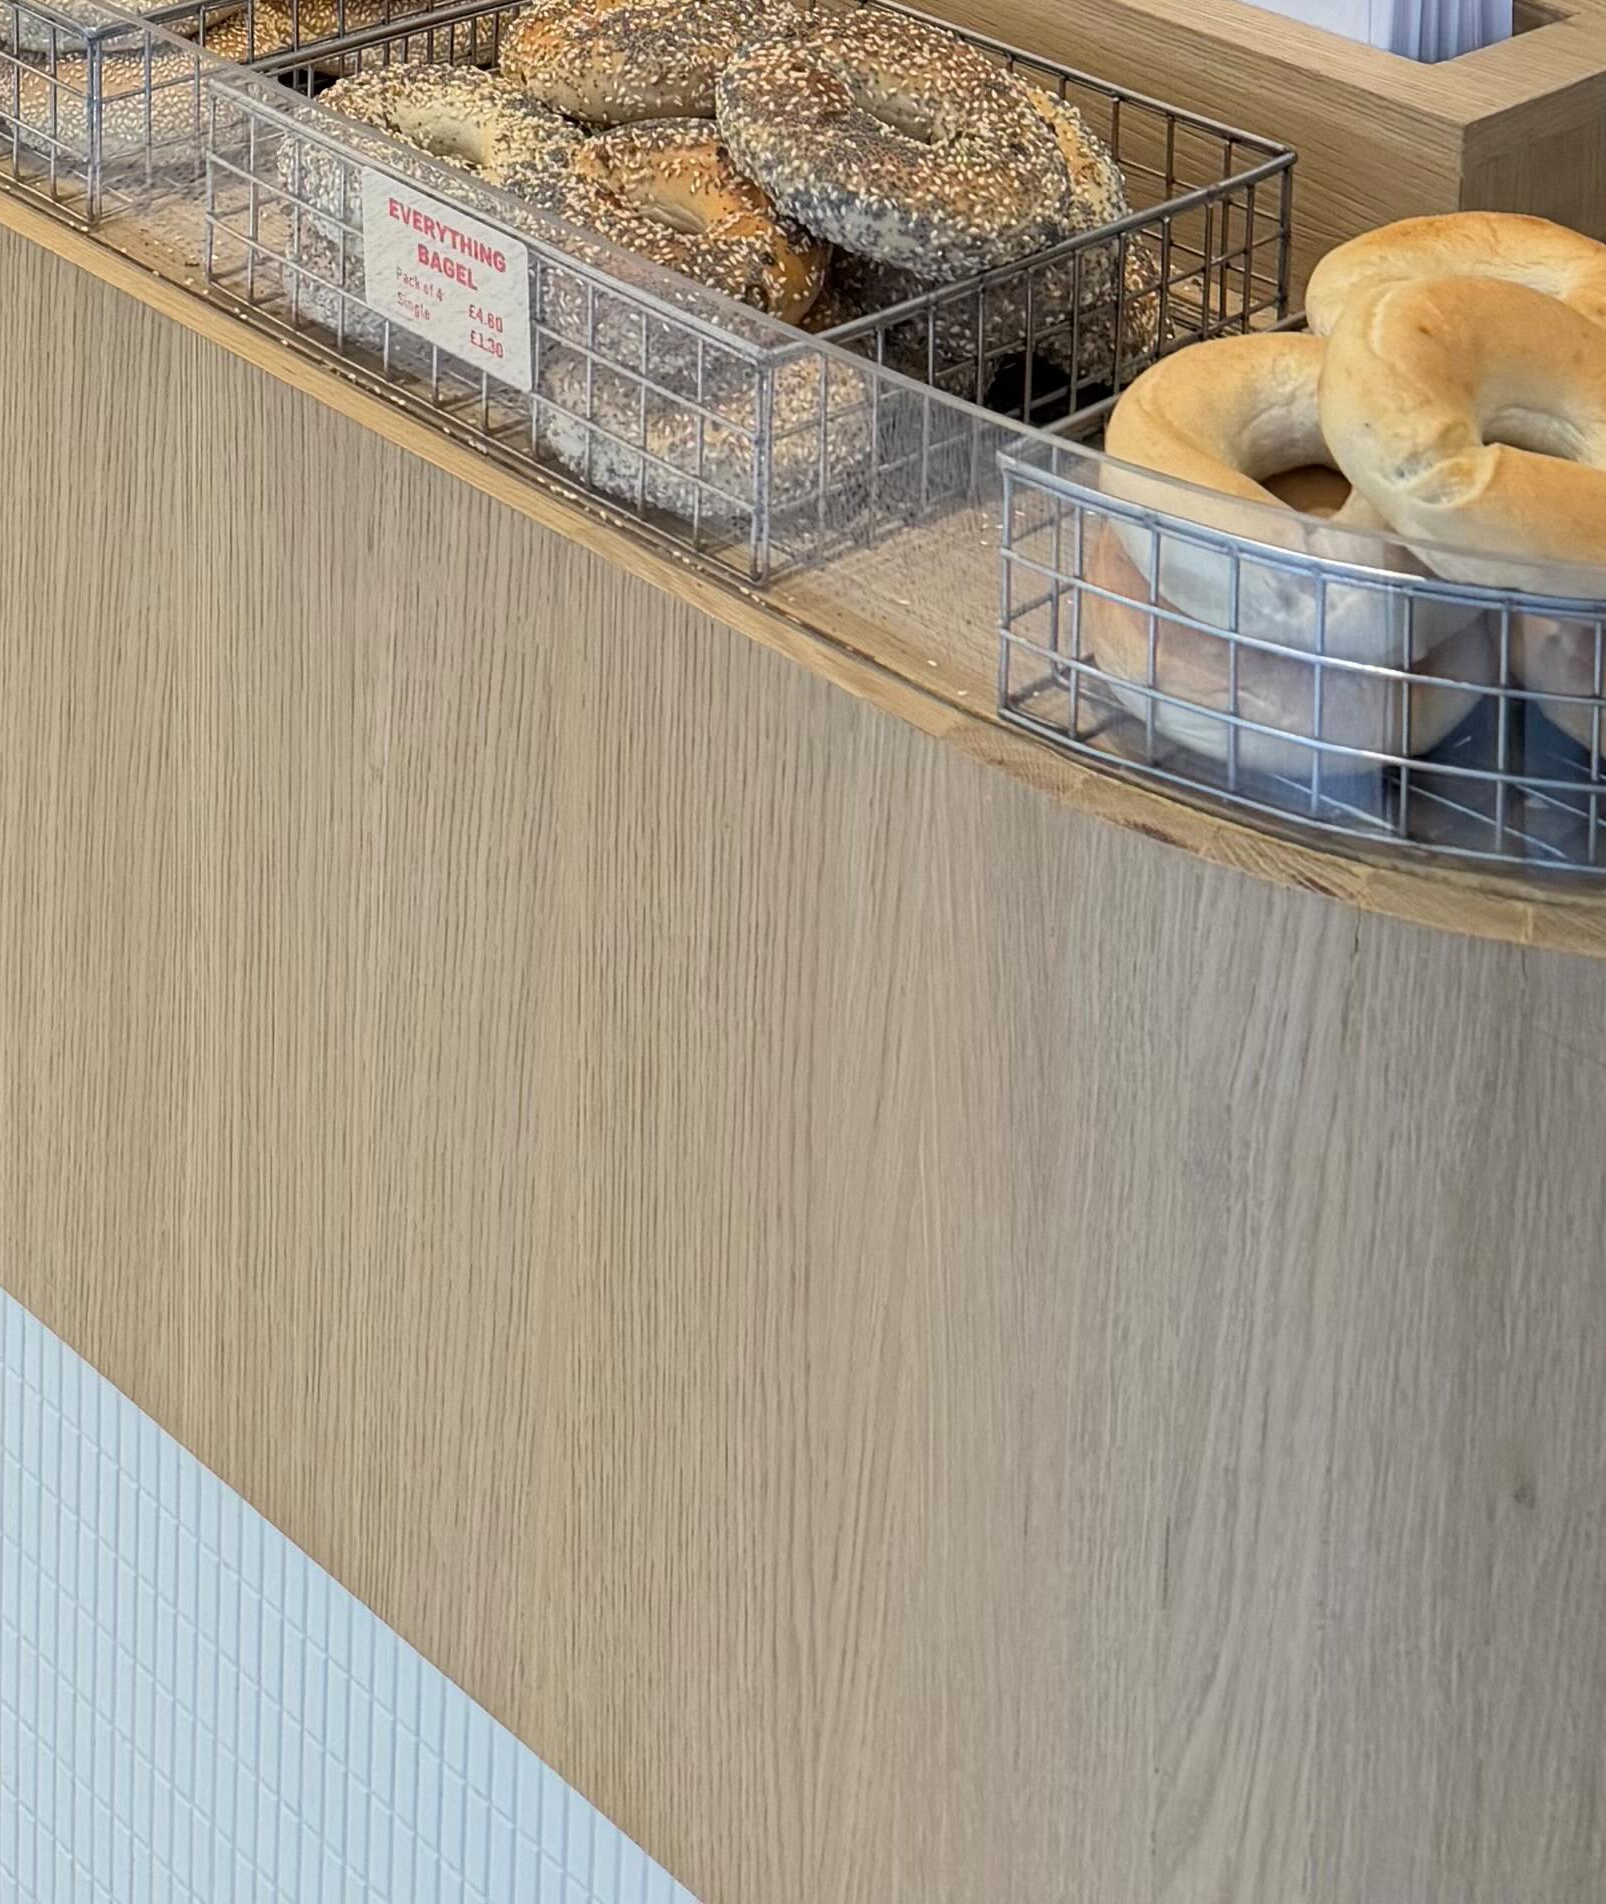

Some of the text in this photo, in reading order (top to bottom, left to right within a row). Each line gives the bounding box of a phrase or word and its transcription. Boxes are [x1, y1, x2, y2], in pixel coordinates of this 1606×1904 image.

[387, 197, 507, 273] EVERYTHING
[396, 266, 423, 292] Pack
[423, 281, 435, 298] of
[435, 287, 444, 303] 4
[417, 243, 478, 291] BAGEL
[397, 292, 504, 359] Single £1.30
